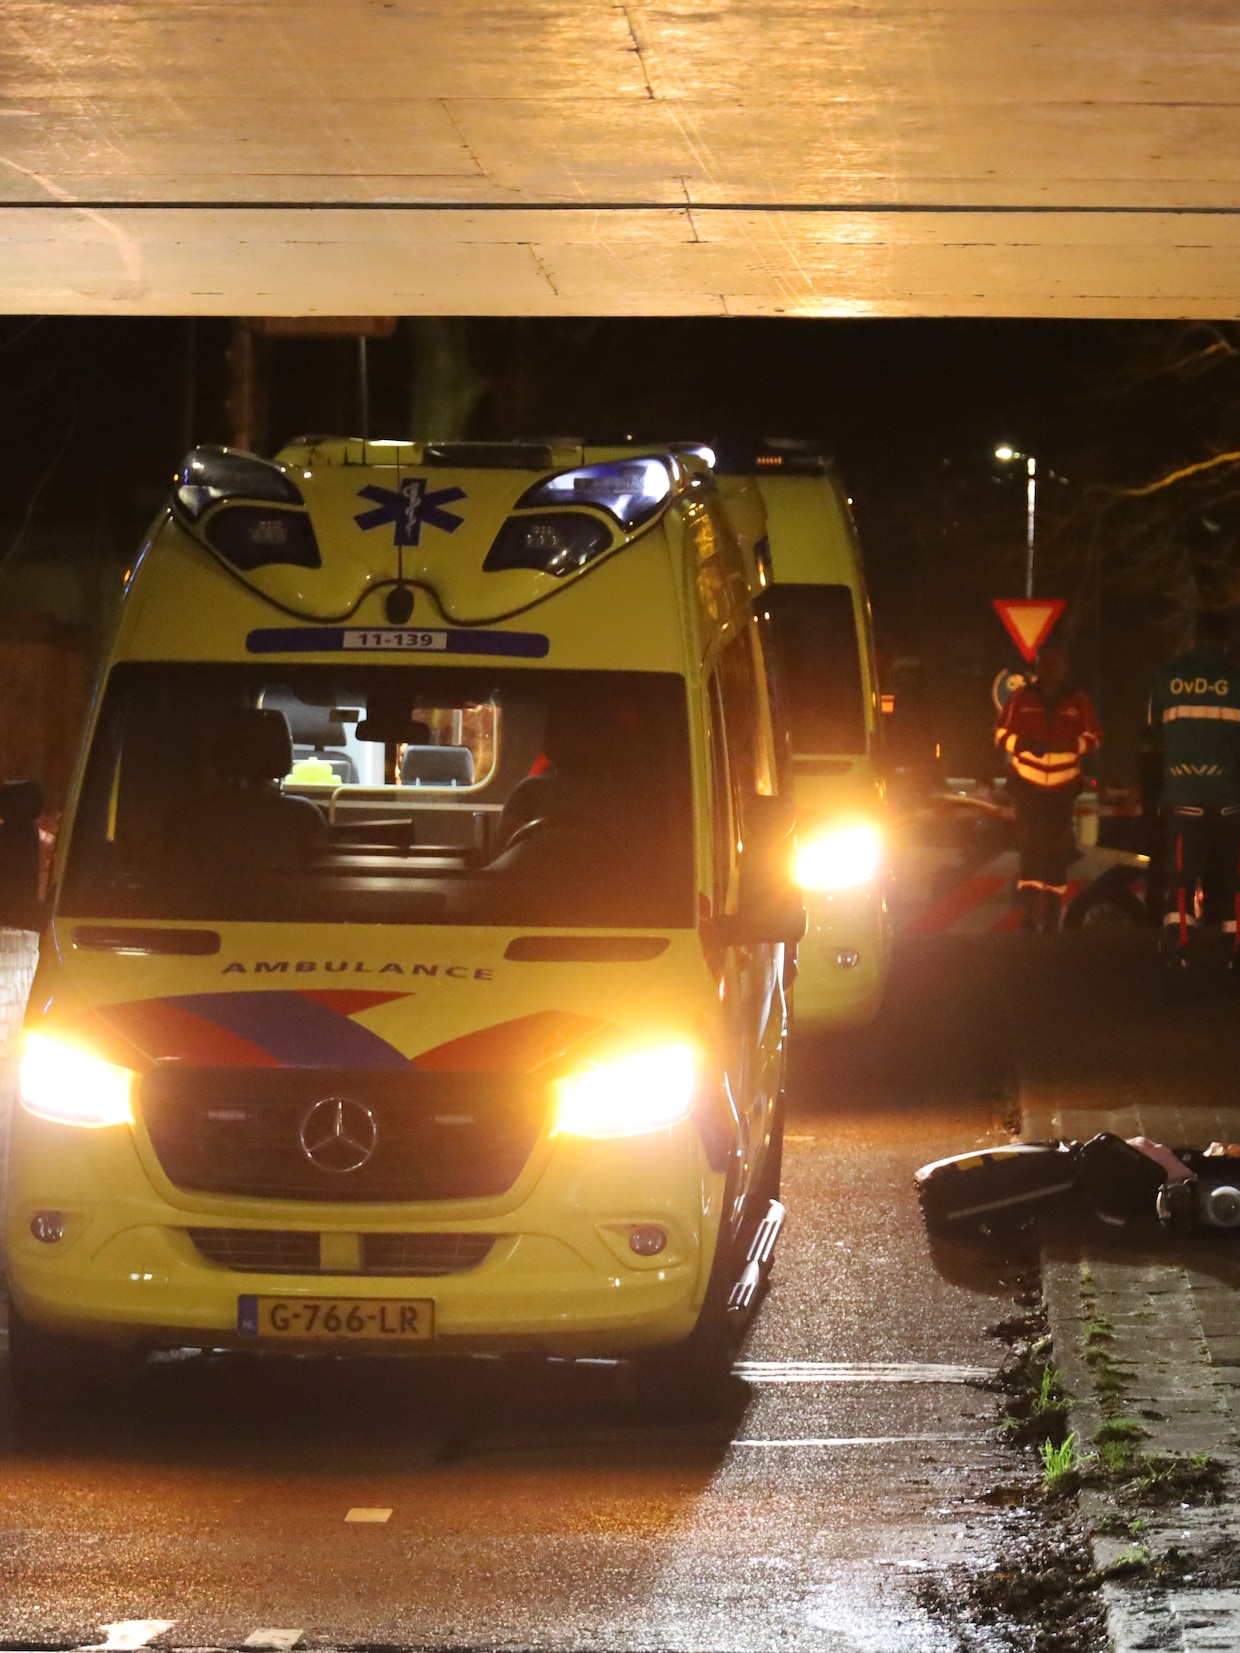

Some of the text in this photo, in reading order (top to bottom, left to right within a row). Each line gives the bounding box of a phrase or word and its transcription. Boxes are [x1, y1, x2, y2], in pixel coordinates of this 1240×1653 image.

[358, 633, 432, 646] 11-139
[1170, 677, 1229, 697] OvD-G
[222, 961, 494, 981] AMBULANCE
[242, 1319, 254, 1330] NL
[270, 1303, 419, 1334] G-766-LR
